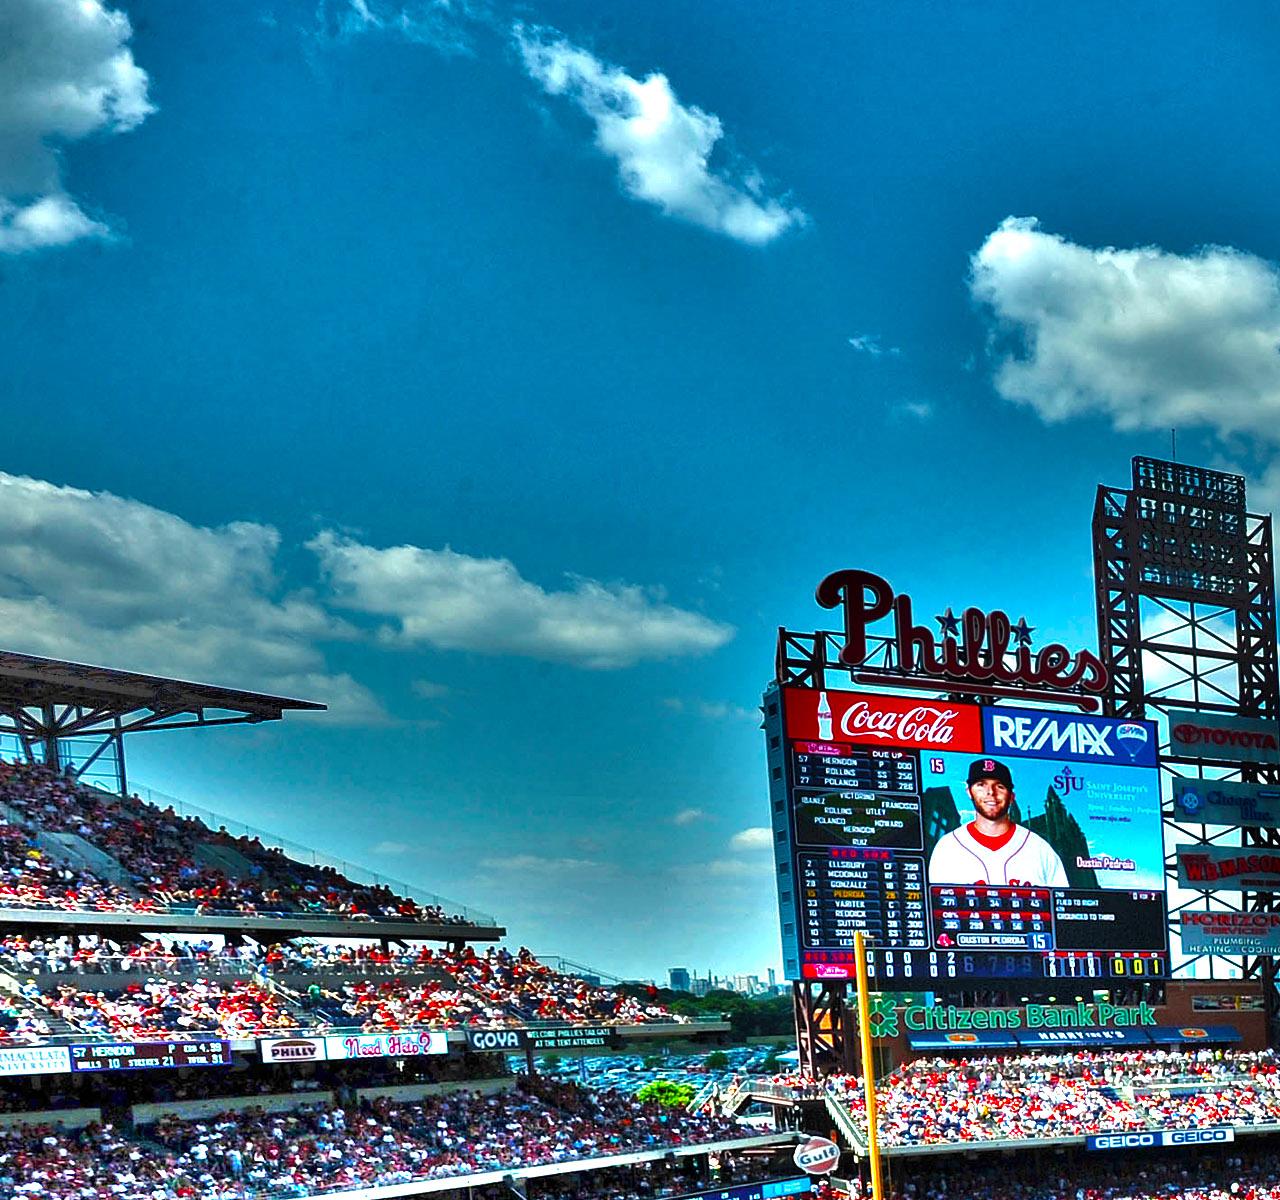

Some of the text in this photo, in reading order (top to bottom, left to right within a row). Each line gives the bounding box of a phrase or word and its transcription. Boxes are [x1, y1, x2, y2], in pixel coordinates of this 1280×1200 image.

[815, 568, 1109, 692] Phillies
[840, 701, 960, 744] Coca-Cola
[992, 714, 1115, 757] RE/MAX
[1200, 727, 1279, 752] TOYOTA
[929, 758, 944, 773] 15
[825, 768, 856, 777] ROLLINS
[824, 777, 859, 787] POLANCO
[1053, 774, 1084, 796] SJU
[1086, 781, 1148, 794] SAINT JOSEPH'S
[1087, 790, 1136, 801] UNIVERSITY
[824, 806, 853, 815] ROLLINS
[814, 816, 846, 825] POLANCO
[852, 838, 868, 846] RUIZ
[1076, 856, 1136, 870] Dustin Pedroia
[1202, 926, 1269, 936] SERVICES
[1032, 935, 1046, 950] 15
[1213, 937, 1261, 946] PLUMBING
[1189, 944, 1232, 954] HEATING
[948, 951, 956, 964] 2
[1114, 959, 1159, 974] 0 0 1
[903, 1000, 1157, 1031] Citizens Bank Park
[473, 1032, 519, 1049] GOYA
[526, 1030, 556, 1039] WELCOME
[557, 1029, 583, 1038] PHILLIES
[1037, 1031, 1084, 1041] HARRY
[345, 1037, 382, 1057] Need
[534, 1039, 543, 1048] AT
[543, 1039, 555, 1047] THE
[555, 1038, 570, 1047] TENT
[72, 1044, 175, 1058] 57 HERNDON P
[271, 1044, 317, 1057] PHILLY
[108, 1058, 121, 1069] 10
[162, 1056, 174, 1067] 21
[1095, 1134, 1154, 1149] GEICO
[1171, 1130, 1227, 1143] GEICO
[799, 1146, 837, 1167] Gulf
